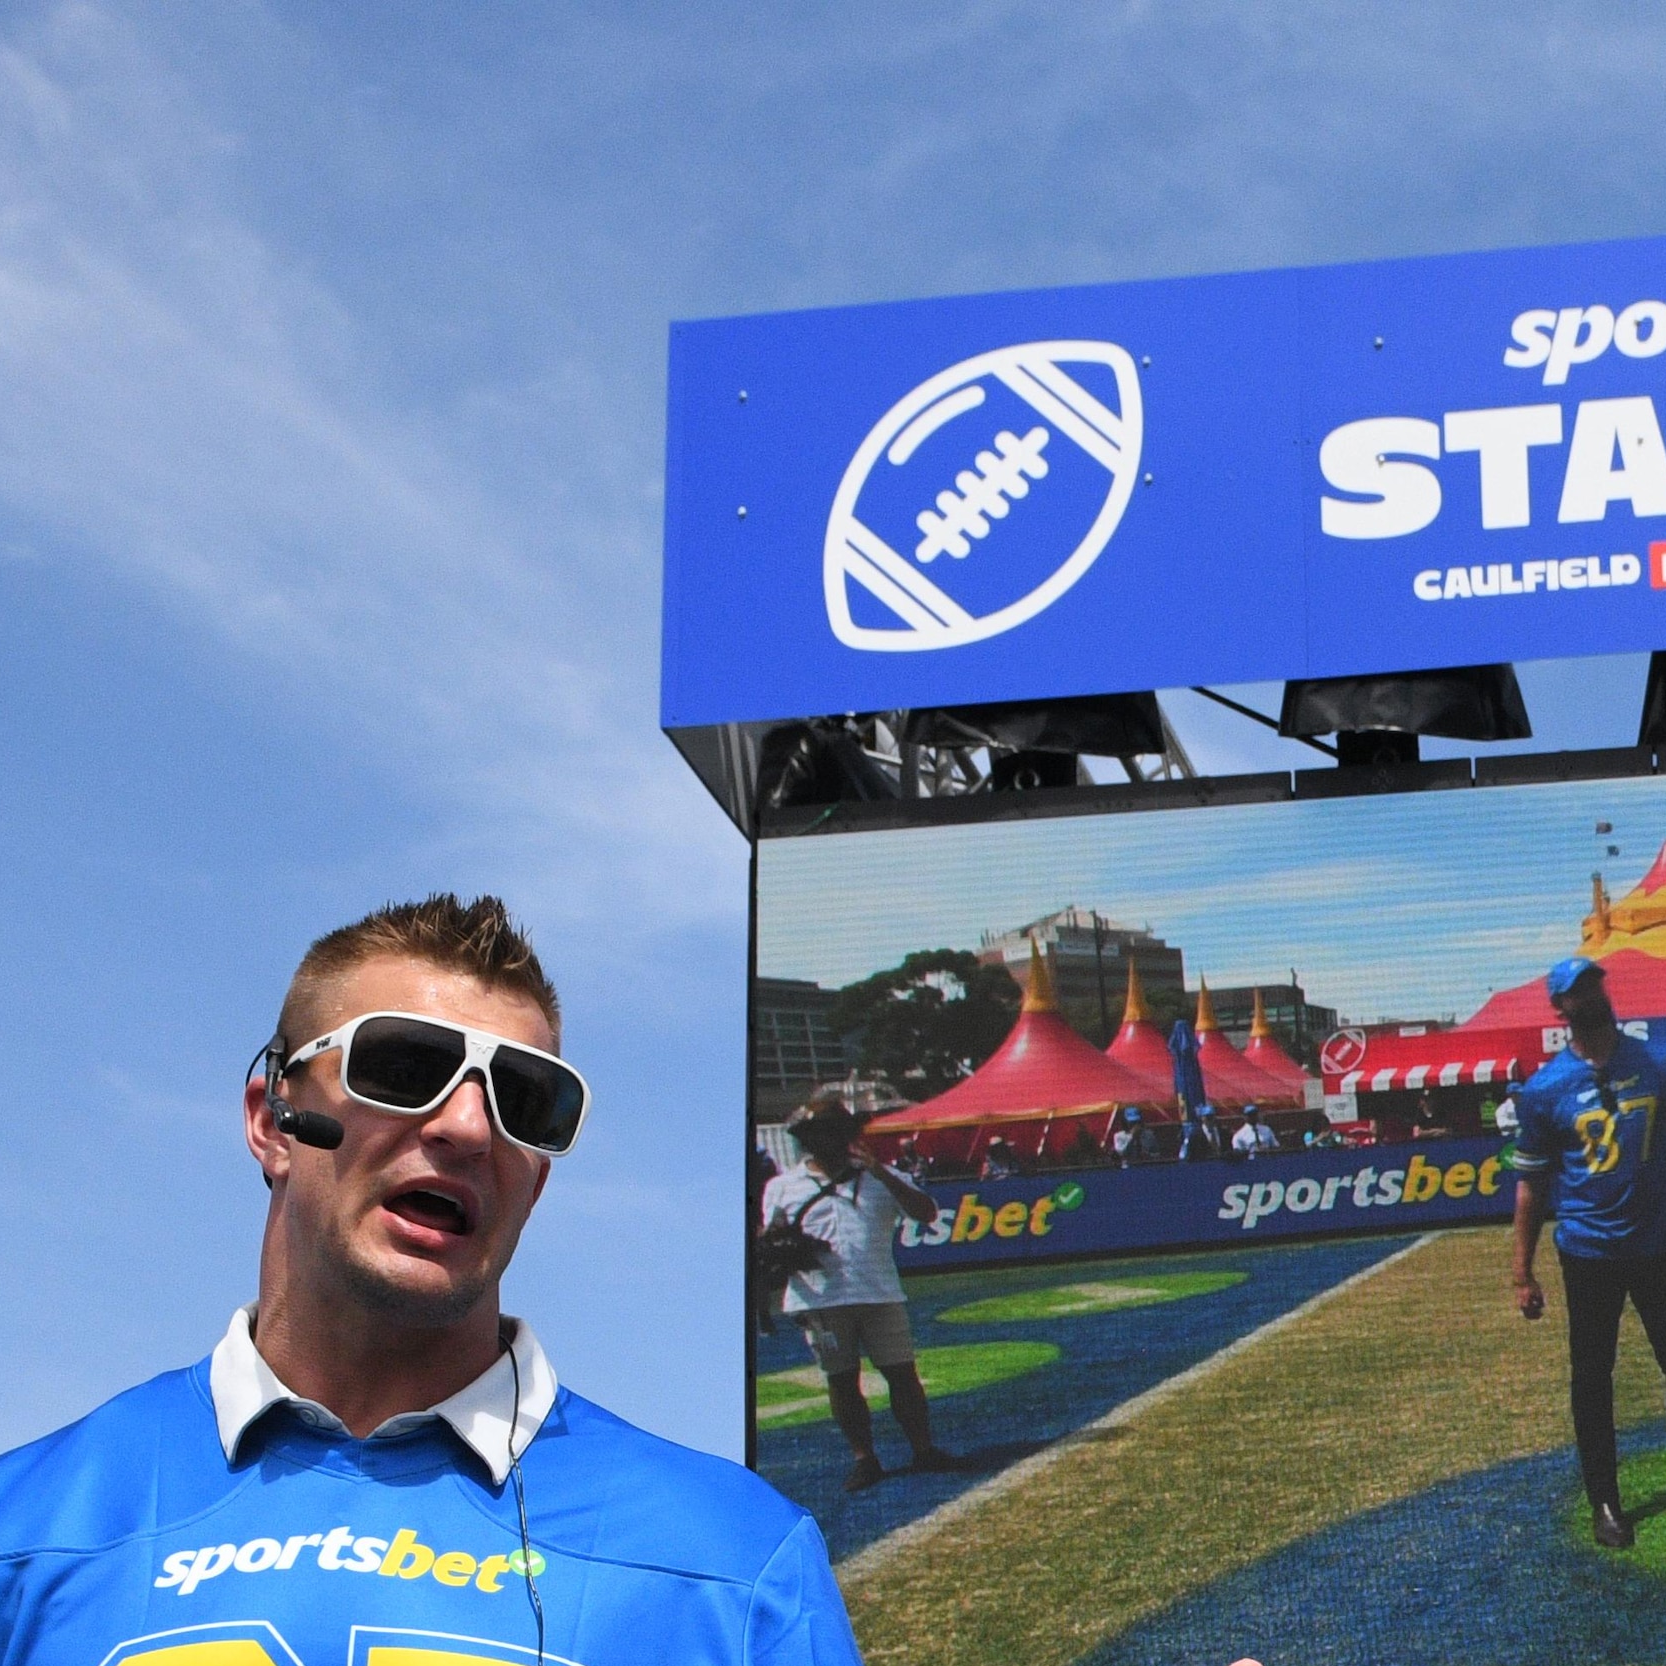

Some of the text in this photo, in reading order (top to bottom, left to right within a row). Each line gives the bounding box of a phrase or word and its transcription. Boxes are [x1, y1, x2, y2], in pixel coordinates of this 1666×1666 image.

[1413, 554, 1640, 601] CAULFIELD
[895, 1193, 1056, 1248] tsbet
[1218, 1154, 1502, 1230] sportsbet
[154, 1526, 510, 1594] sportsbet
